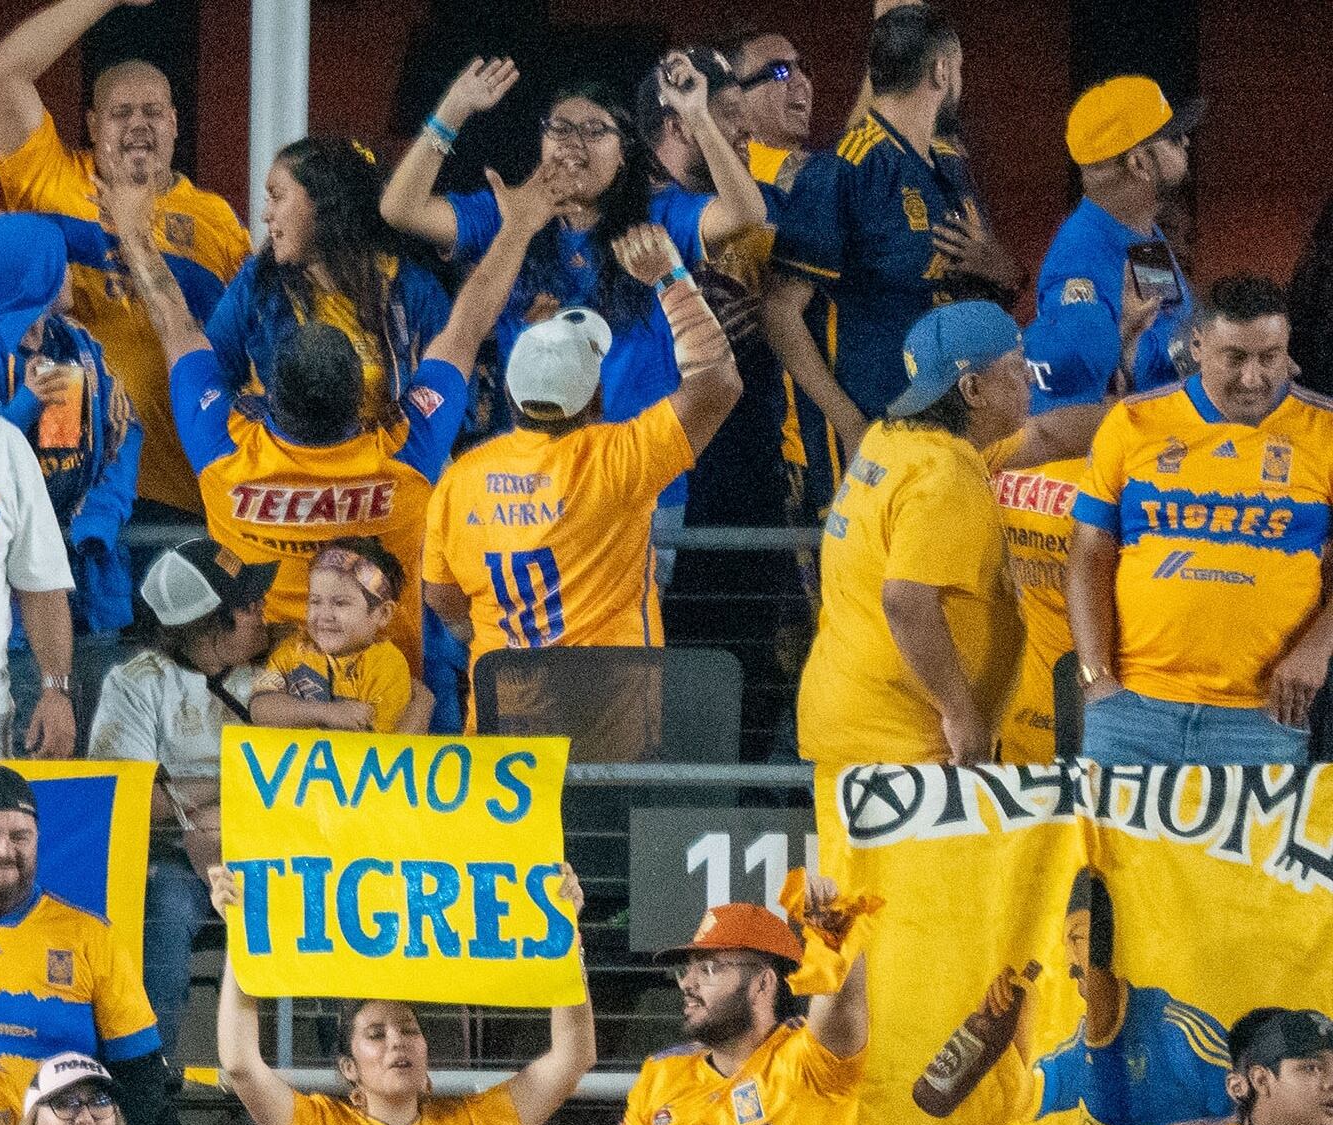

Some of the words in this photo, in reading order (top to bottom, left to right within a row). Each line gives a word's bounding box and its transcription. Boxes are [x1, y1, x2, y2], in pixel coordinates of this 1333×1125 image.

[232, 482, 398, 524] TECATE
[1141, 500, 1293, 539] TIGRES
[486, 548, 564, 648] 10
[240, 739, 537, 825] VAMOS
[226, 855, 576, 960] TIGRES
